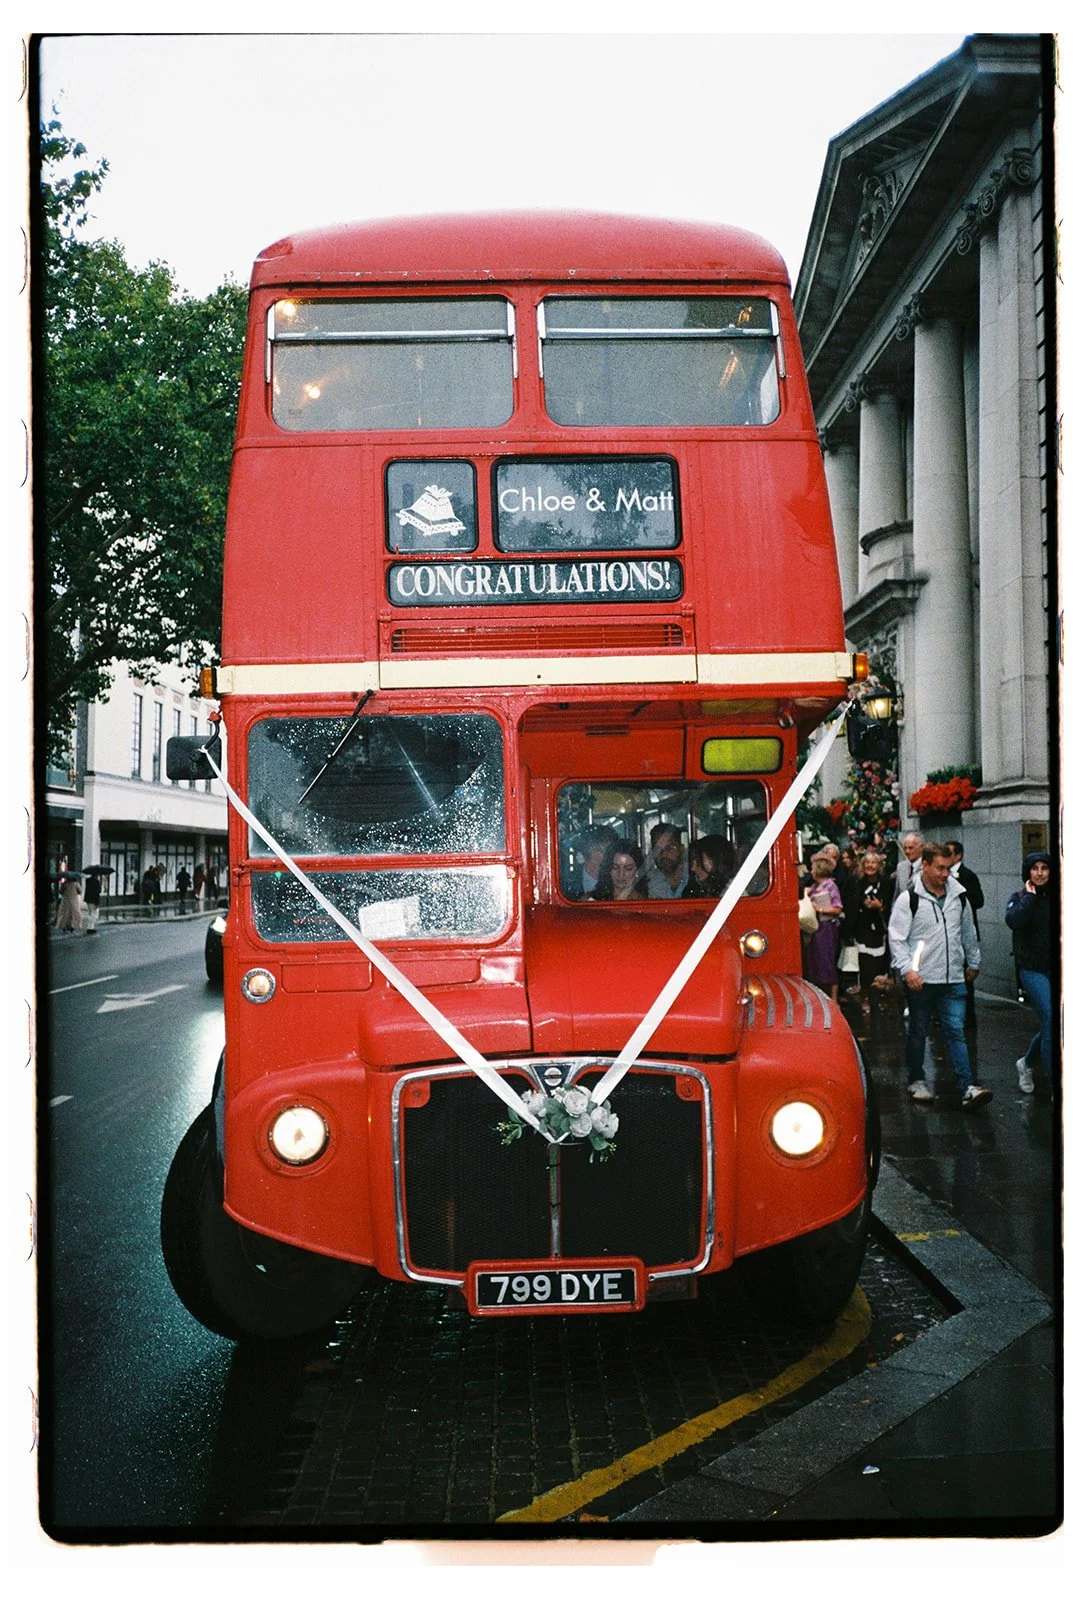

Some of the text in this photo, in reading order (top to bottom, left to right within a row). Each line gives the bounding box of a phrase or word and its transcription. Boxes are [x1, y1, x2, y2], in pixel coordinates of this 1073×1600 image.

[500, 487, 674, 513] Chloe & Matt
[396, 561, 672, 597] CONGRATULATIONS!
[490, 1273, 622, 1303] 799 DYE
